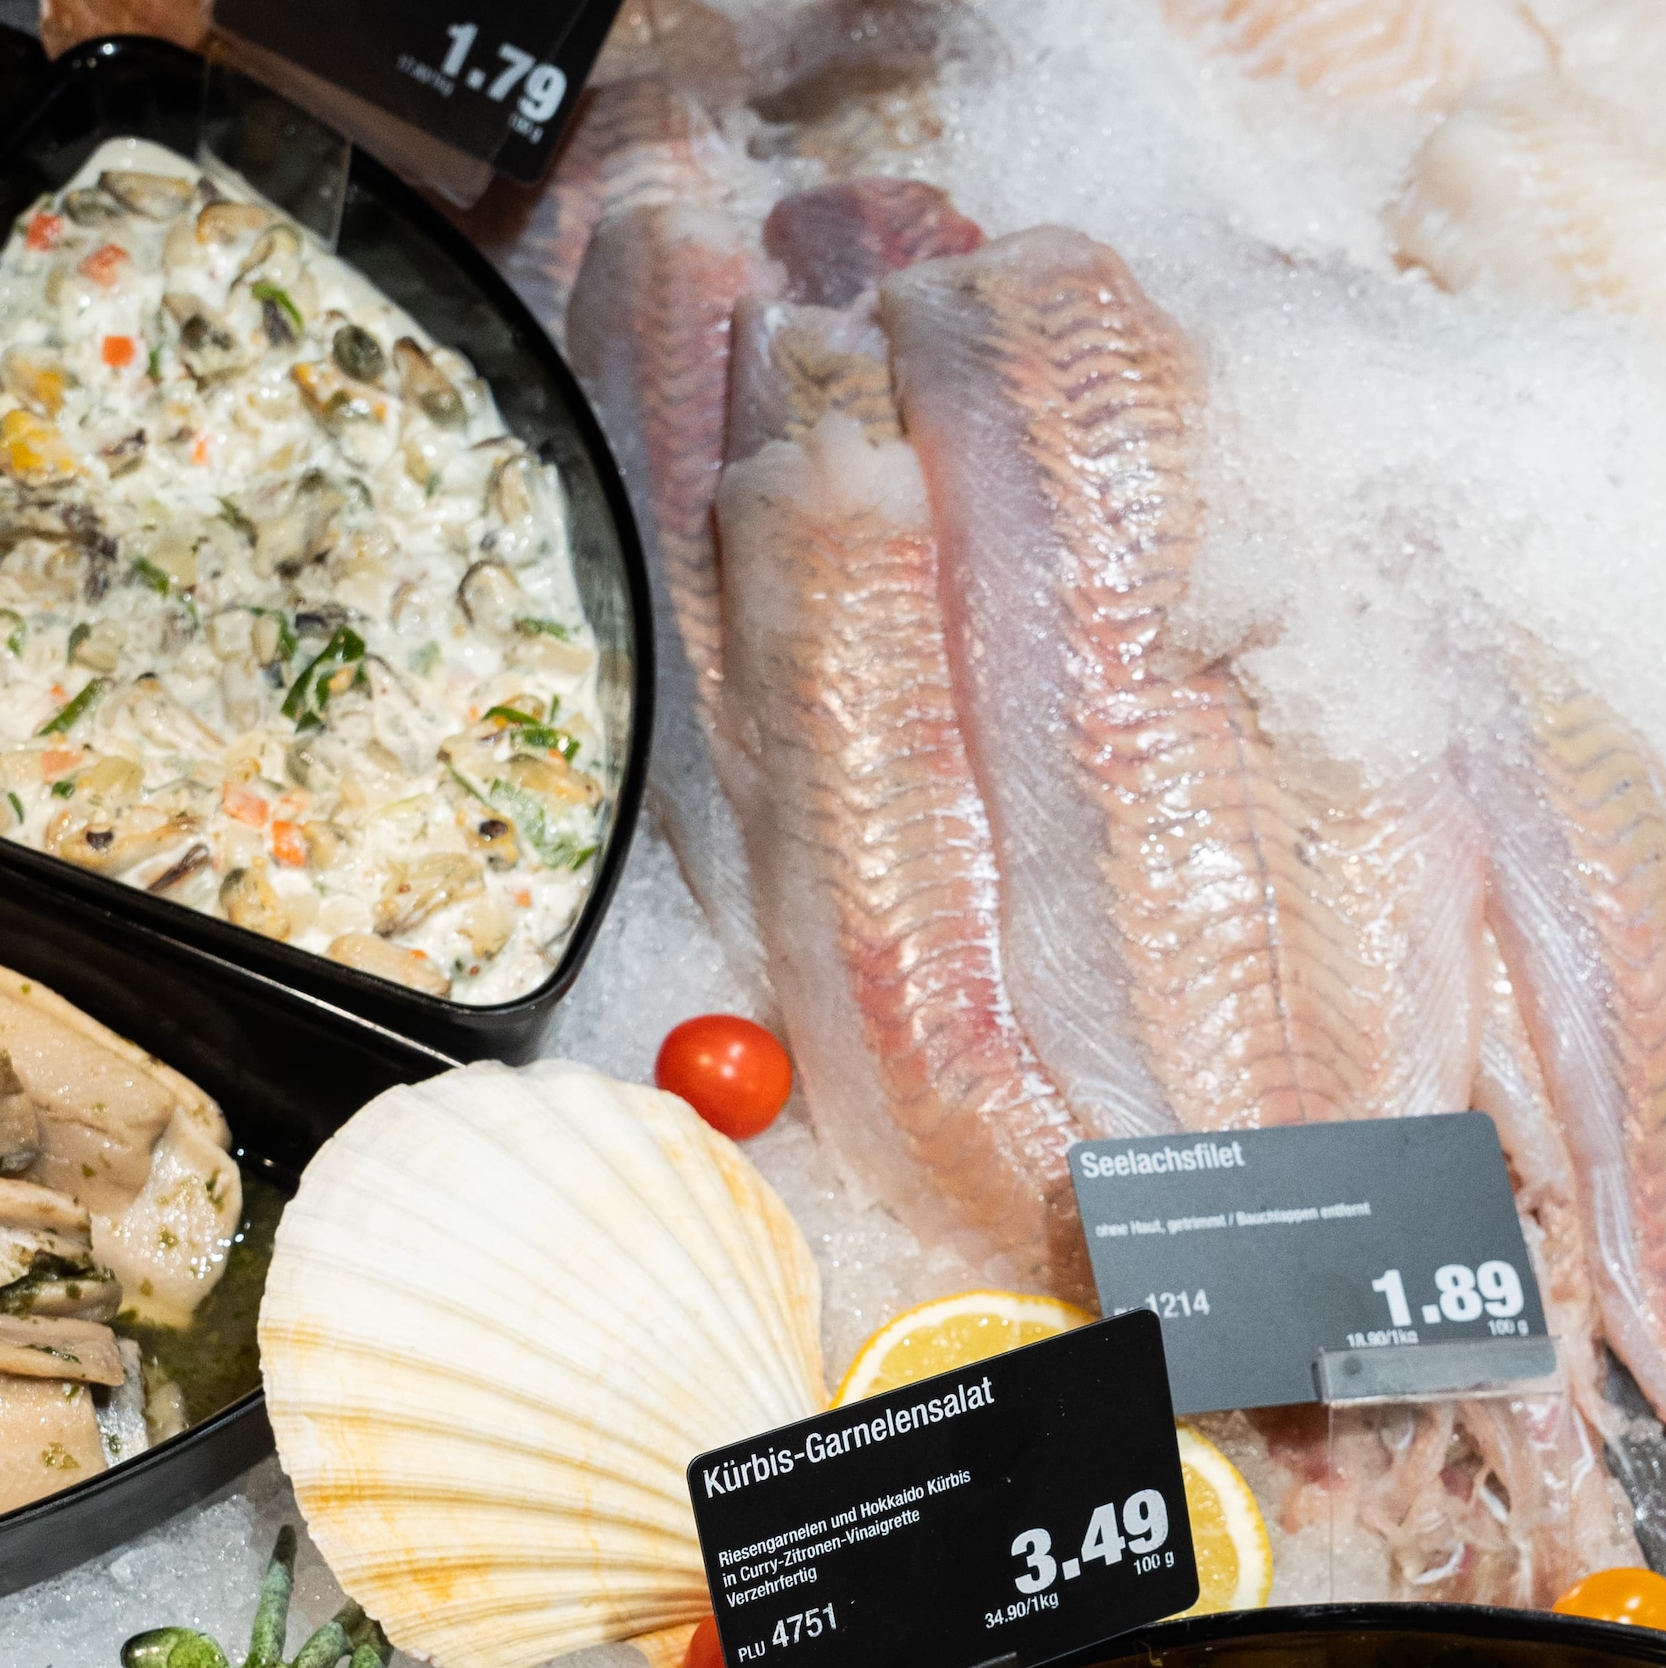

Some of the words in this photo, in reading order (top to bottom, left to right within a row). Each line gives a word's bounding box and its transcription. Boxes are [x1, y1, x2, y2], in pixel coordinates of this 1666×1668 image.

[443, 24, 566, 122] 1.79
[1080, 1141, 1245, 1178] Seelachsfilet
[1096, 1223, 1128, 1237] ohne
[1235, 1208, 1319, 1226] Bauchlappen
[1320, 1202, 1371, 1219] entfernt
[1145, 1289, 1210, 1318] 1214
[1372, 1260, 1524, 1327] 1.89
[1488, 1319, 1513, 1335] 100
[1511, 1320, 1529, 1336] g
[704, 1377, 994, 1498] Kürbis-Garnelensalat
[719, 1520, 827, 1567] Riesengarnelen
[831, 1507, 857, 1528] und
[860, 1487, 924, 1518] Hokkaido
[927, 1470, 971, 1495] Kürbis
[1011, 1489, 1168, 1594] 3.49
[723, 1573, 737, 1587] in
[740, 1510, 920, 1581] Curry-Zitronen-Vinaigrette
[1134, 1554, 1160, 1574] 100
[1165, 1552, 1174, 1567] g
[726, 1567, 817, 1607] Verzehrfertig
[985, 1593, 1059, 1628] 34.90/1kg
[738, 1641, 765, 1662] PLU
[772, 1603, 836, 1647] 4751
